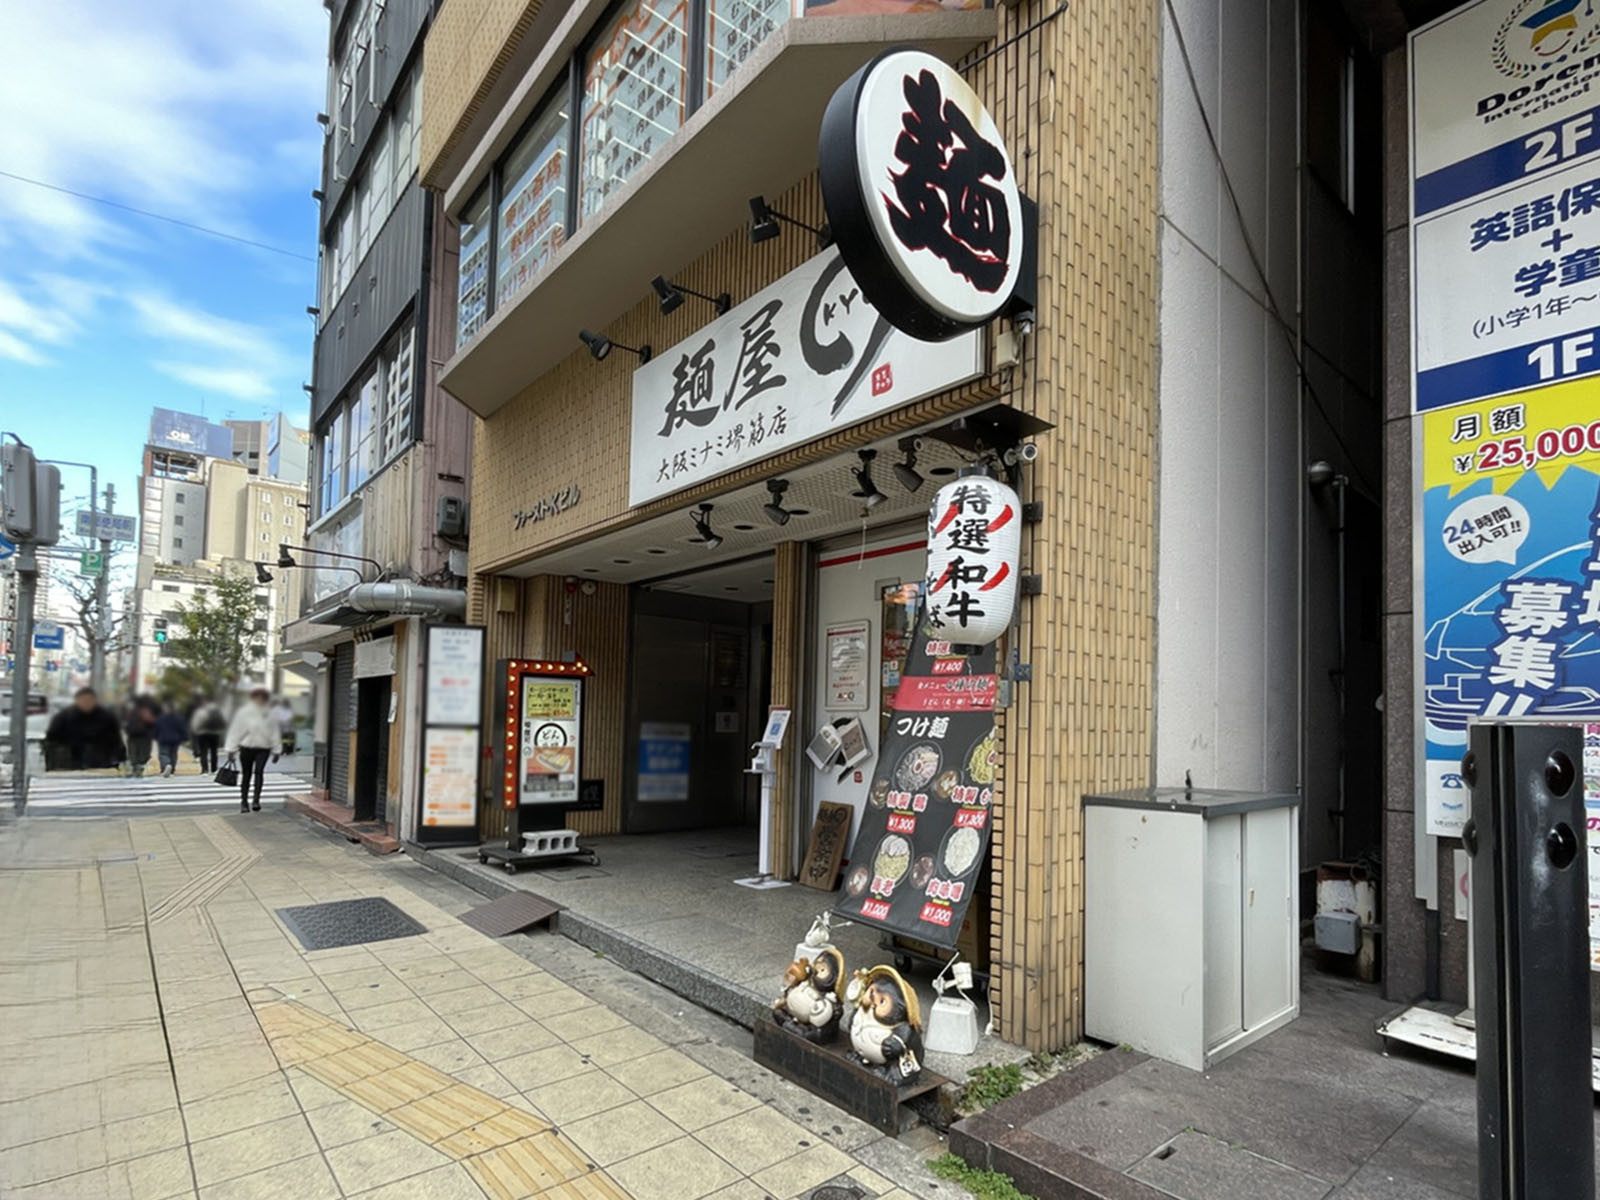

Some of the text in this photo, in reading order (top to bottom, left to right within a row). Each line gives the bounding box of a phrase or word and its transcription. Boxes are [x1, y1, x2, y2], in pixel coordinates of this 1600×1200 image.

[1521, 83, 1590, 118] school
[1525, 113, 1593, 172] 2F
[823, 287, 872, 327] KY
[657, 298, 786, 438] 麺屋
[1527, 332, 1594, 380] 1F
[656, 405, 789, 484] 大阪ミナミ堺筋店
[1443, 506, 1512, 544] 24時間
[86, 553, 99, 567] P
[946, 485, 992, 628] 特選和牛
[897, 716, 950, 738] つけ麺
